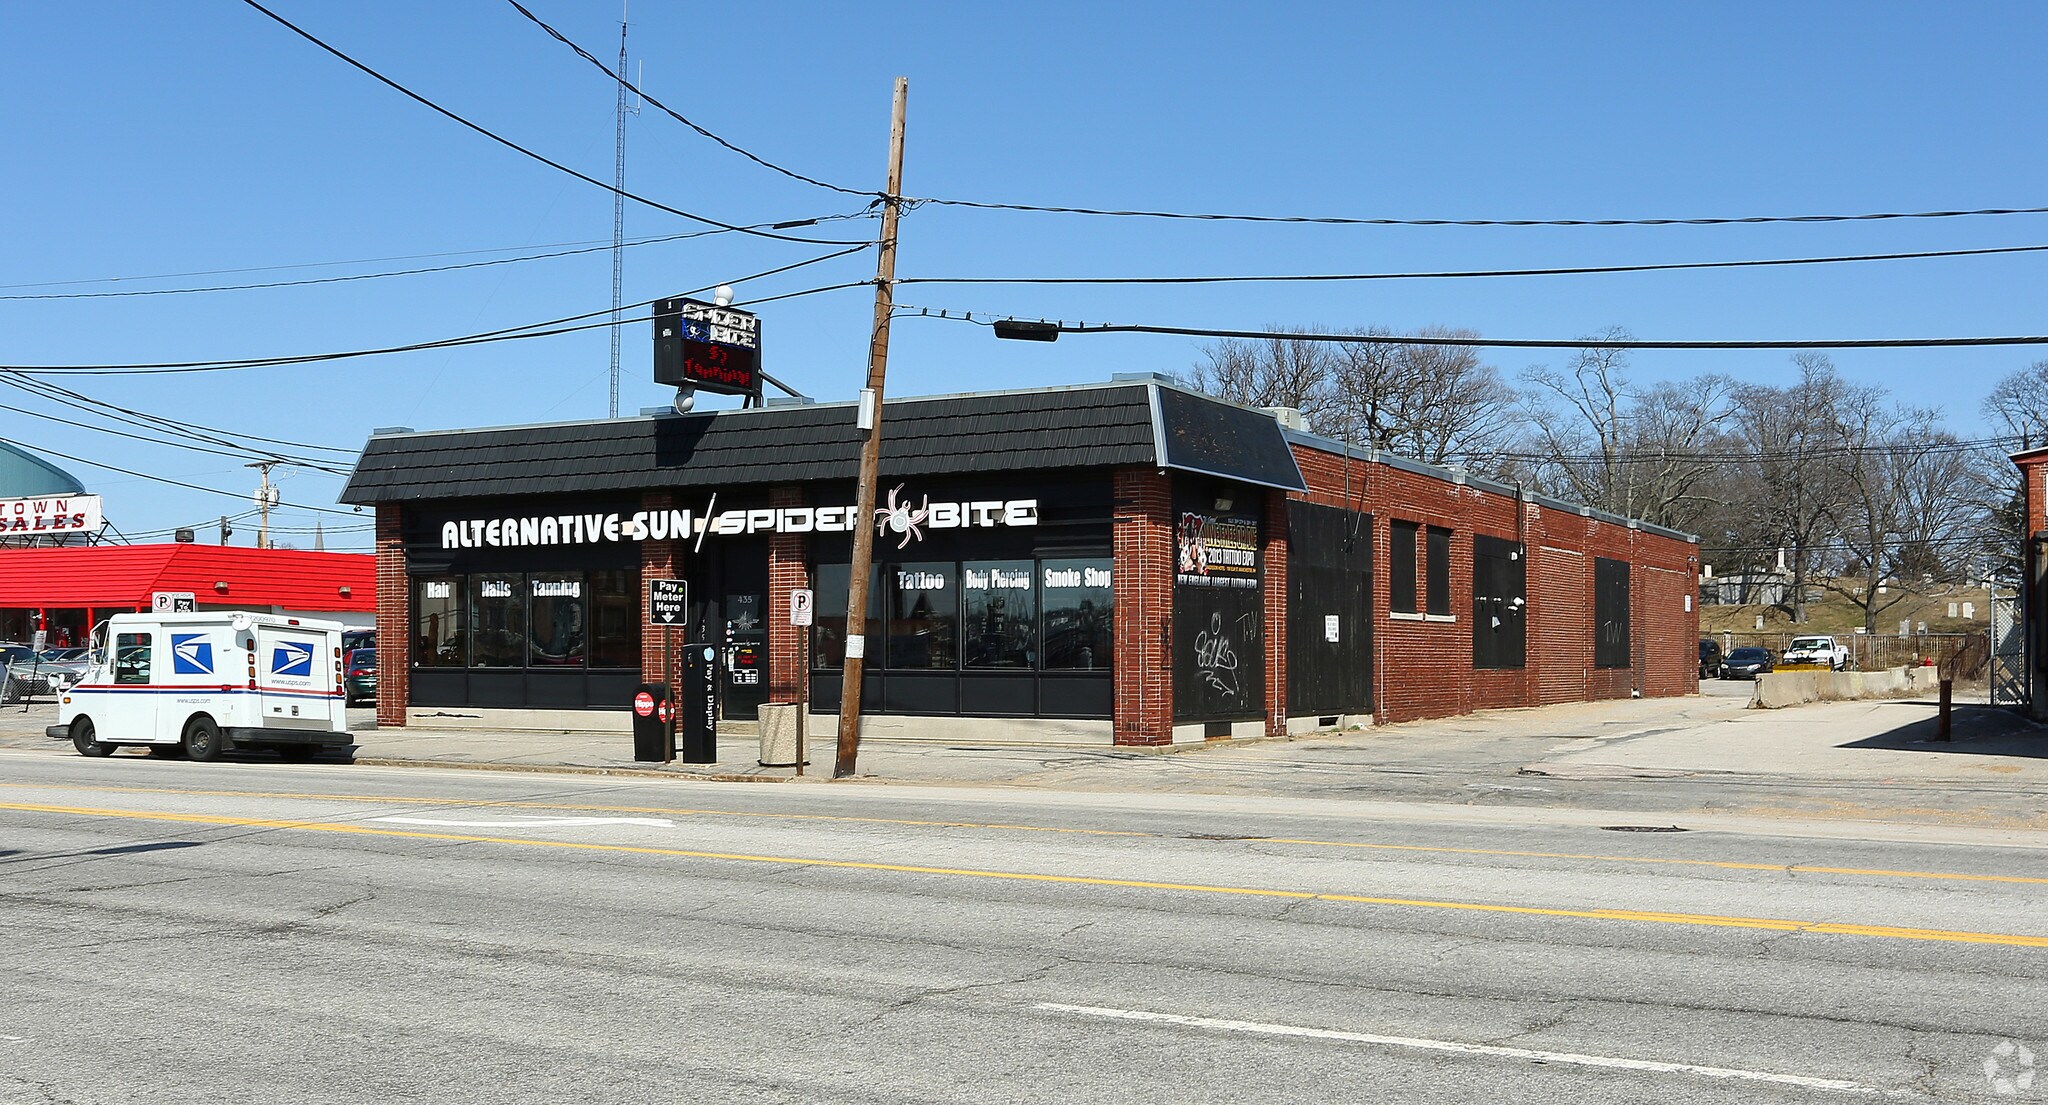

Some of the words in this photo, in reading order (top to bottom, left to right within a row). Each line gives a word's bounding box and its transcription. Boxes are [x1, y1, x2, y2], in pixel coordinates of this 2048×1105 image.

[442, 513, 619, 549] ALTERNATIVE
[632, 509, 691, 541] SUN
[928, 499, 1038, 529] BITE
[1209, 548, 1222, 564] 2013
[1223, 549, 1242, 566] TATTOO
[1242, 551, 1255, 567] EXPO
[897, 571, 944, 590] Tattoo
[965, 569, 988, 590] Body
[991, 568, 1030, 590] Piercing
[1045, 568, 1081, 588] Smoke
[1084, 567, 1111, 589] Shop
[426, 582, 450, 598] Hair
[482, 581, 512, 598] Nails
[532, 580, 581, 598] Tanning
[659, 582, 677, 592] Pay
[653, 592, 683, 601] Meter
[738, 596, 752, 604] 435
[656, 602, 680, 612] Here
[705, 664, 713, 681] Pay
[271, 679, 311, 687] www.usps.com
[635, 699, 654, 708] Hippo
[706, 695, 714, 731] Display
